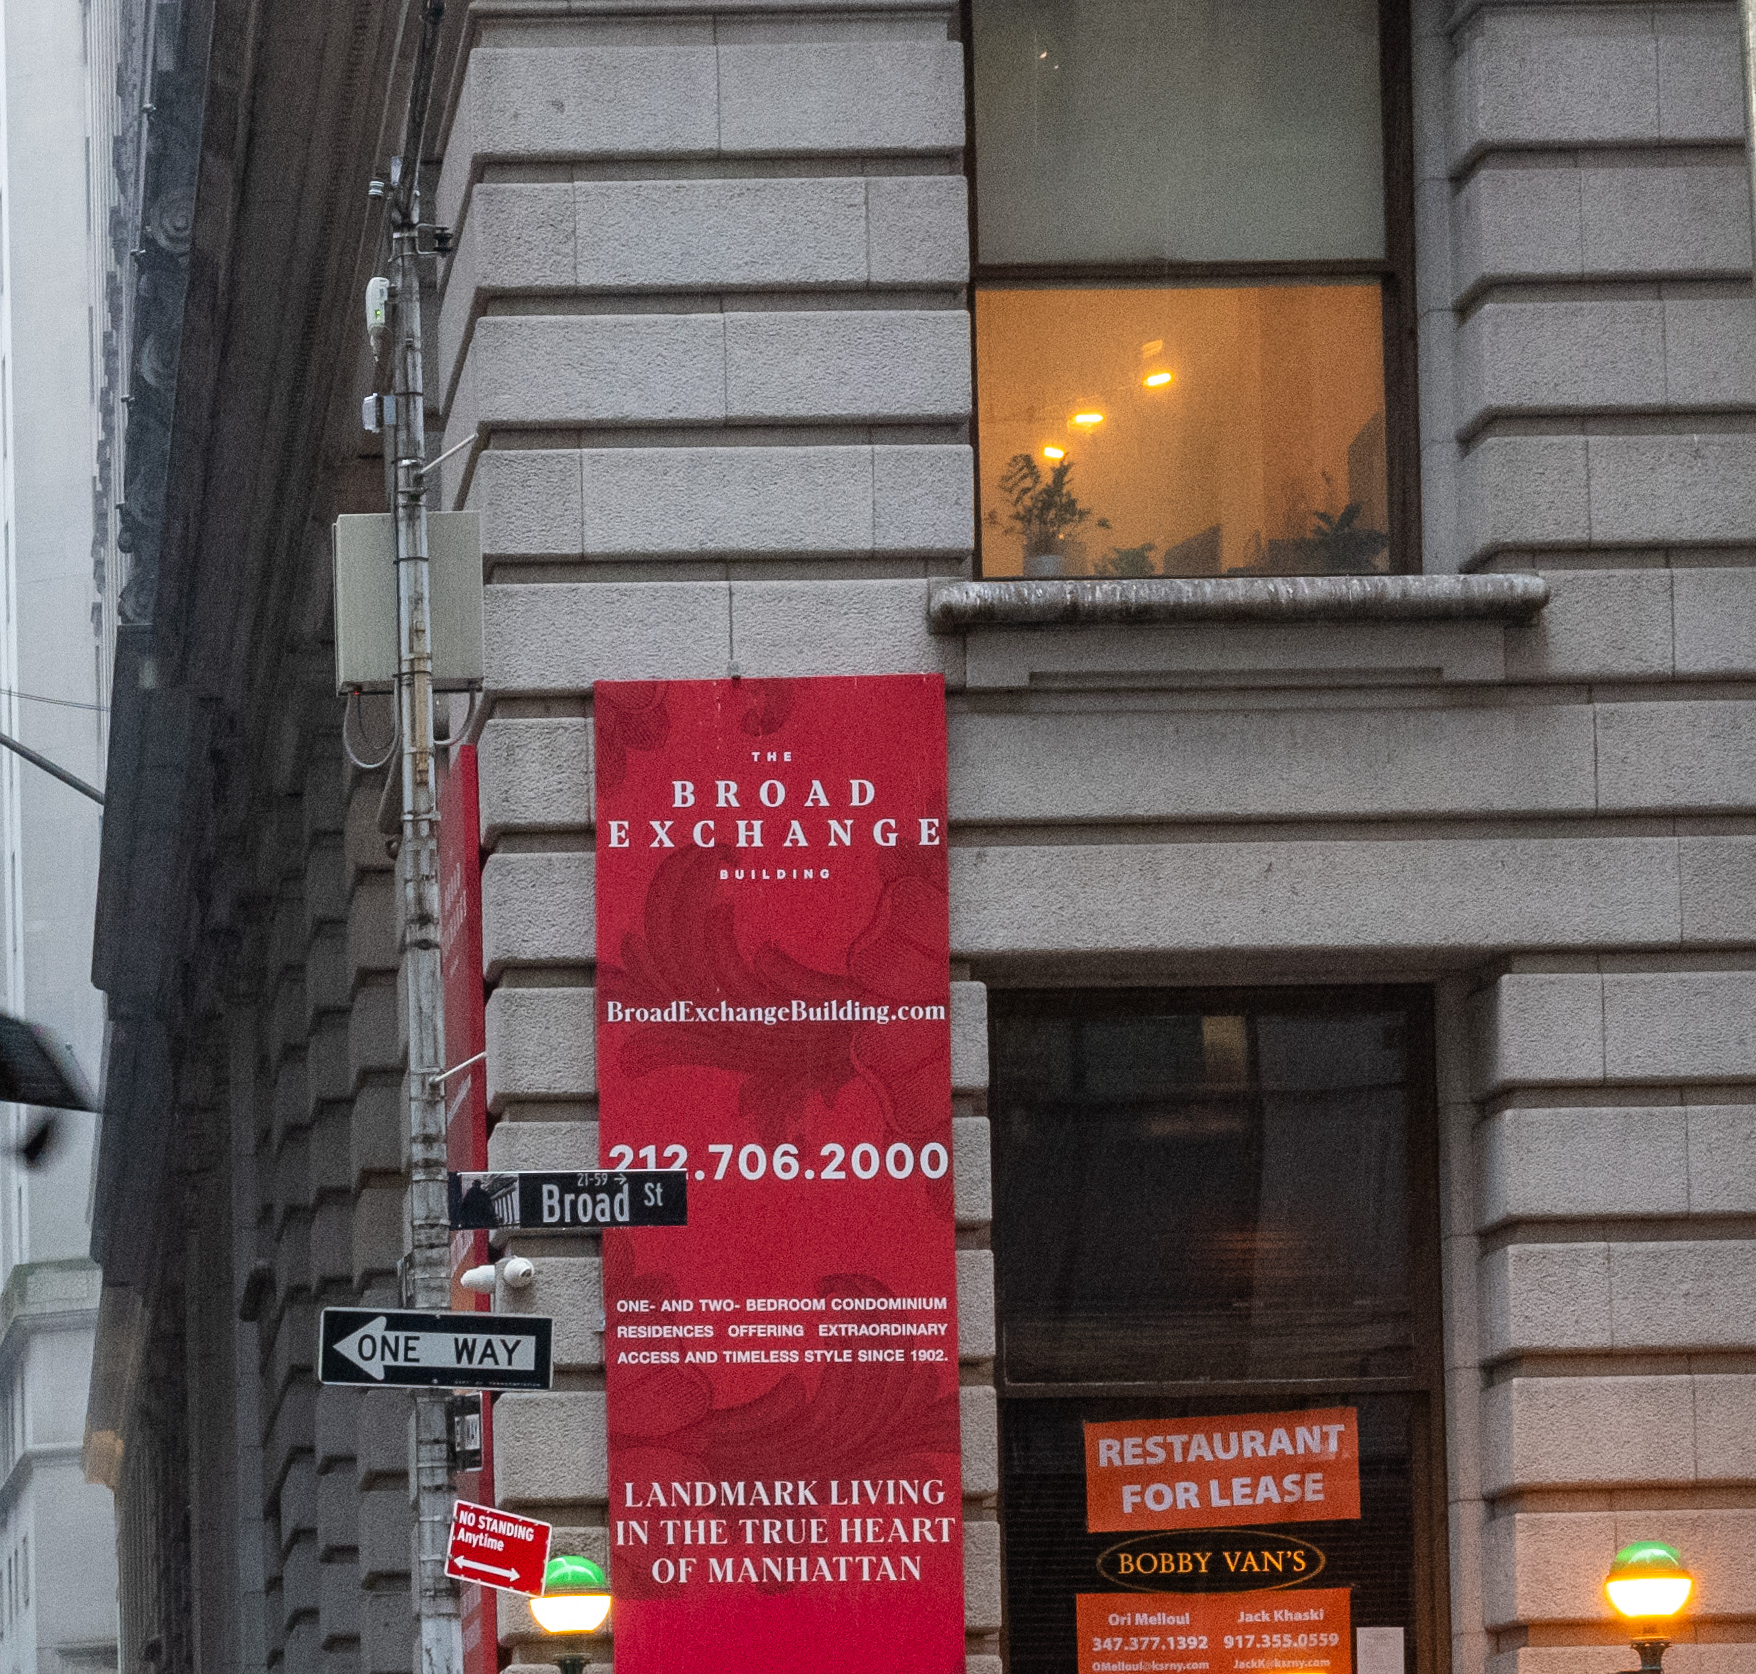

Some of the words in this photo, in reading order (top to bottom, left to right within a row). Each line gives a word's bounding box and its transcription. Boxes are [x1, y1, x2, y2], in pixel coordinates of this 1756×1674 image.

[752, 751, 793, 762] THE
[672, 779, 877, 808] BROAD
[608, 817, 941, 848] EXCHANGE
[719, 869, 831, 880] BUILDING
[606, 1000, 946, 1024] BroadExchangeBuilding.com
[609, 1142, 949, 1181] 212.706.2000
[577, 1173, 608, 1187] 21-59
[542, 1183, 630, 1223] Broad
[643, 1182, 664, 1207] St
[616, 1300, 656, 1312] ONE-
[661, 1300, 694, 1312] AND
[699, 1299, 741, 1312] TWO-
[746, 1298, 826, 1311] BEDROOM
[831, 1297, 947, 1310] CONDOMINIUM
[617, 1325, 714, 1338] RESIDENCES
[728, 1324, 804, 1337] OFFERING
[818, 1323, 948, 1336] EXTRAORDINARY
[357, 1334, 420, 1363] ONE
[454, 1337, 522, 1366] WAY
[617, 1351, 680, 1364] ACCESS
[684, 1351, 718, 1363] AND
[723, 1350, 799, 1363] TIMELESS
[804, 1350, 852, 1362] STYLE
[857, 1350, 905, 1362] SINCE
[910, 1349, 948, 1362] 1902.
[1098, 1424, 1345, 1468] RESTAURANT
[624, 1480, 818, 1508] LANDMARK
[830, 1479, 946, 1506] LIVING
[1122, 1483, 1202, 1514] FOR
[1210, 1473, 1325, 1508] LEASE
[458, 1510, 476, 1527] NO
[477, 1515, 535, 1542] STANDING
[616, 1519, 650, 1546] IN
[660, 1519, 728, 1545] THE
[739, 1518, 828, 1545] TRUE
[840, 1517, 956, 1544] HEART
[456, 1527, 505, 1552] Anytime
[652, 1558, 696, 1584] OF
[708, 1556, 922, 1583] MANHATTAN
[1118, 1552, 1213, 1575] BOBBY
[1223, 1550, 1306, 1573] VAN'S
[1108, 1613, 1131, 1626] Ori
[1238, 1611, 1270, 1623] Jack
[1092, 1636, 1208, 1651] 347.377.1392
